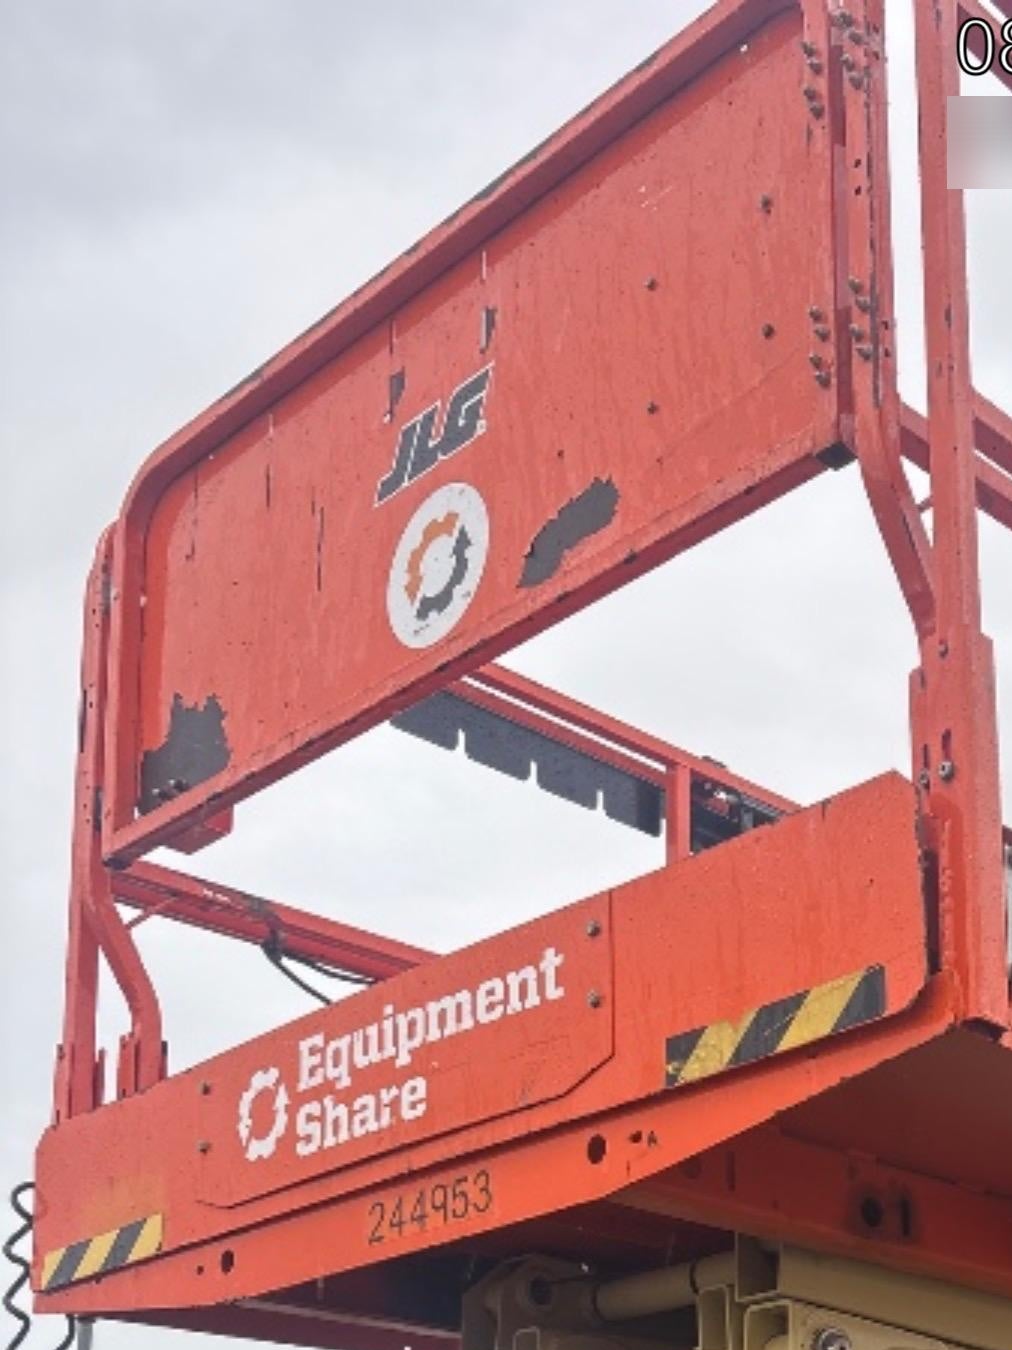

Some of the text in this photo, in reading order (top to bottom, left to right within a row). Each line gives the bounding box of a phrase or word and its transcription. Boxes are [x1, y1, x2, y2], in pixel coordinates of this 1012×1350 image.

[374, 361, 494, 507] JLG
[297, 946, 565, 1093] Equipment
[296, 1075, 427, 1157] Share
[368, 1169, 492, 1246] 244953
